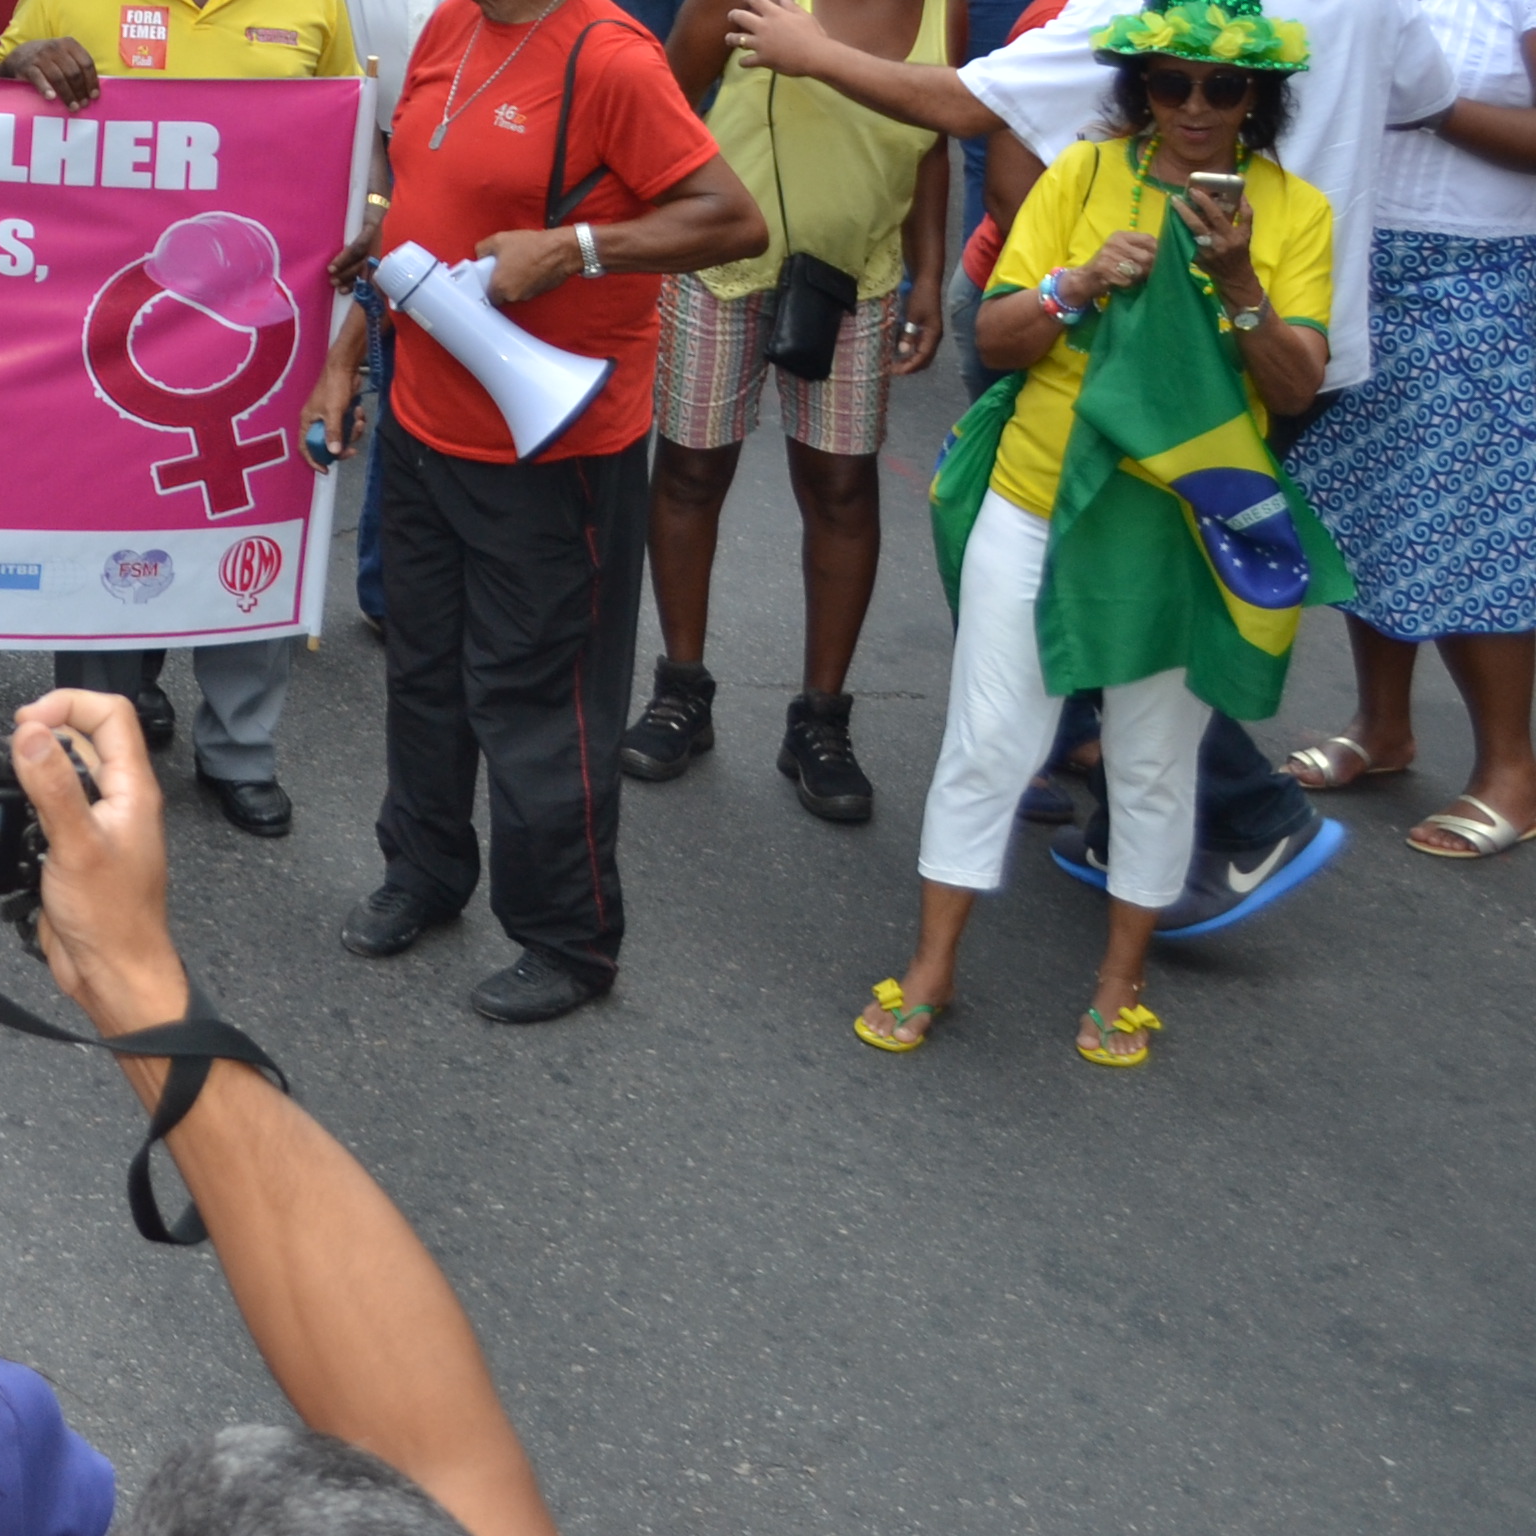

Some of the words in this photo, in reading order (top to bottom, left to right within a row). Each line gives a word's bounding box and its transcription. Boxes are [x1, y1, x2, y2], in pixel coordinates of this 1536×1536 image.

[127, 10, 162, 25] FORA
[122, 24, 166, 40] TEMER
[118, 563, 159, 577] FSM
